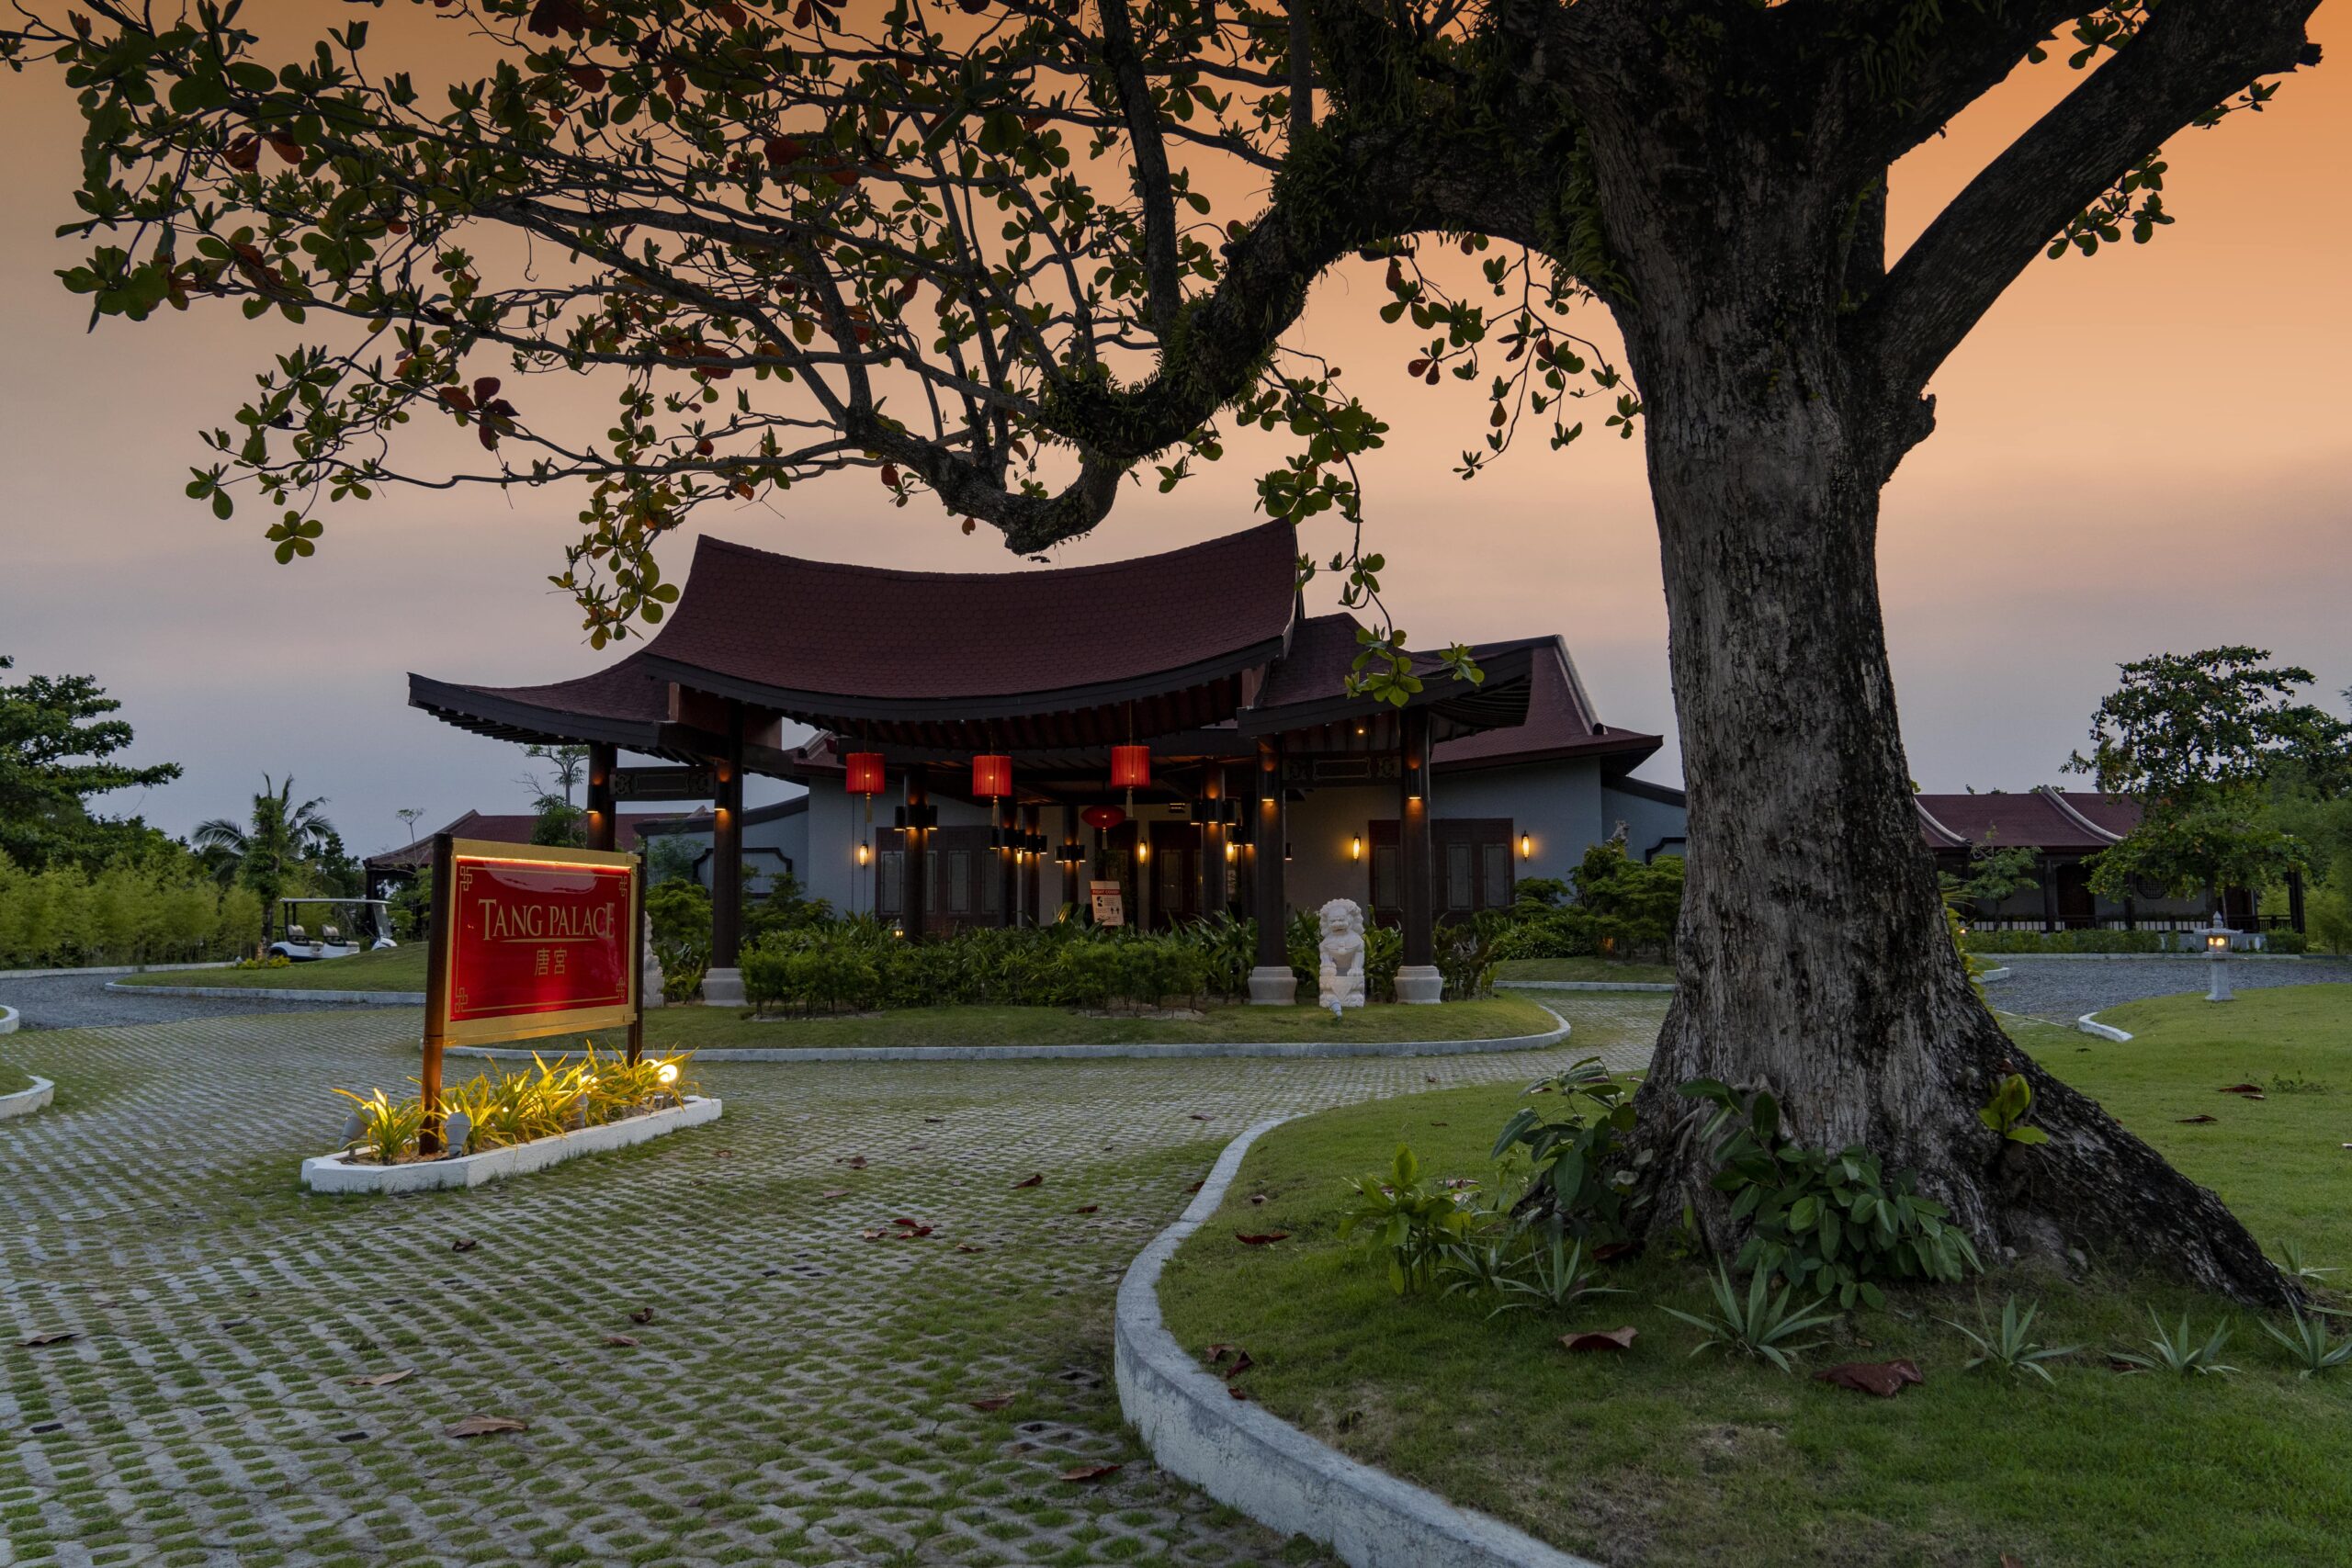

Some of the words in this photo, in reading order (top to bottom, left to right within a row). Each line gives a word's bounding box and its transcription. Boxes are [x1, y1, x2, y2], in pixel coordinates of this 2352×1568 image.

[478, 898, 543, 941] TANG
[548, 902, 615, 938] PALACE
[534, 947, 567, 976] 唐宮
